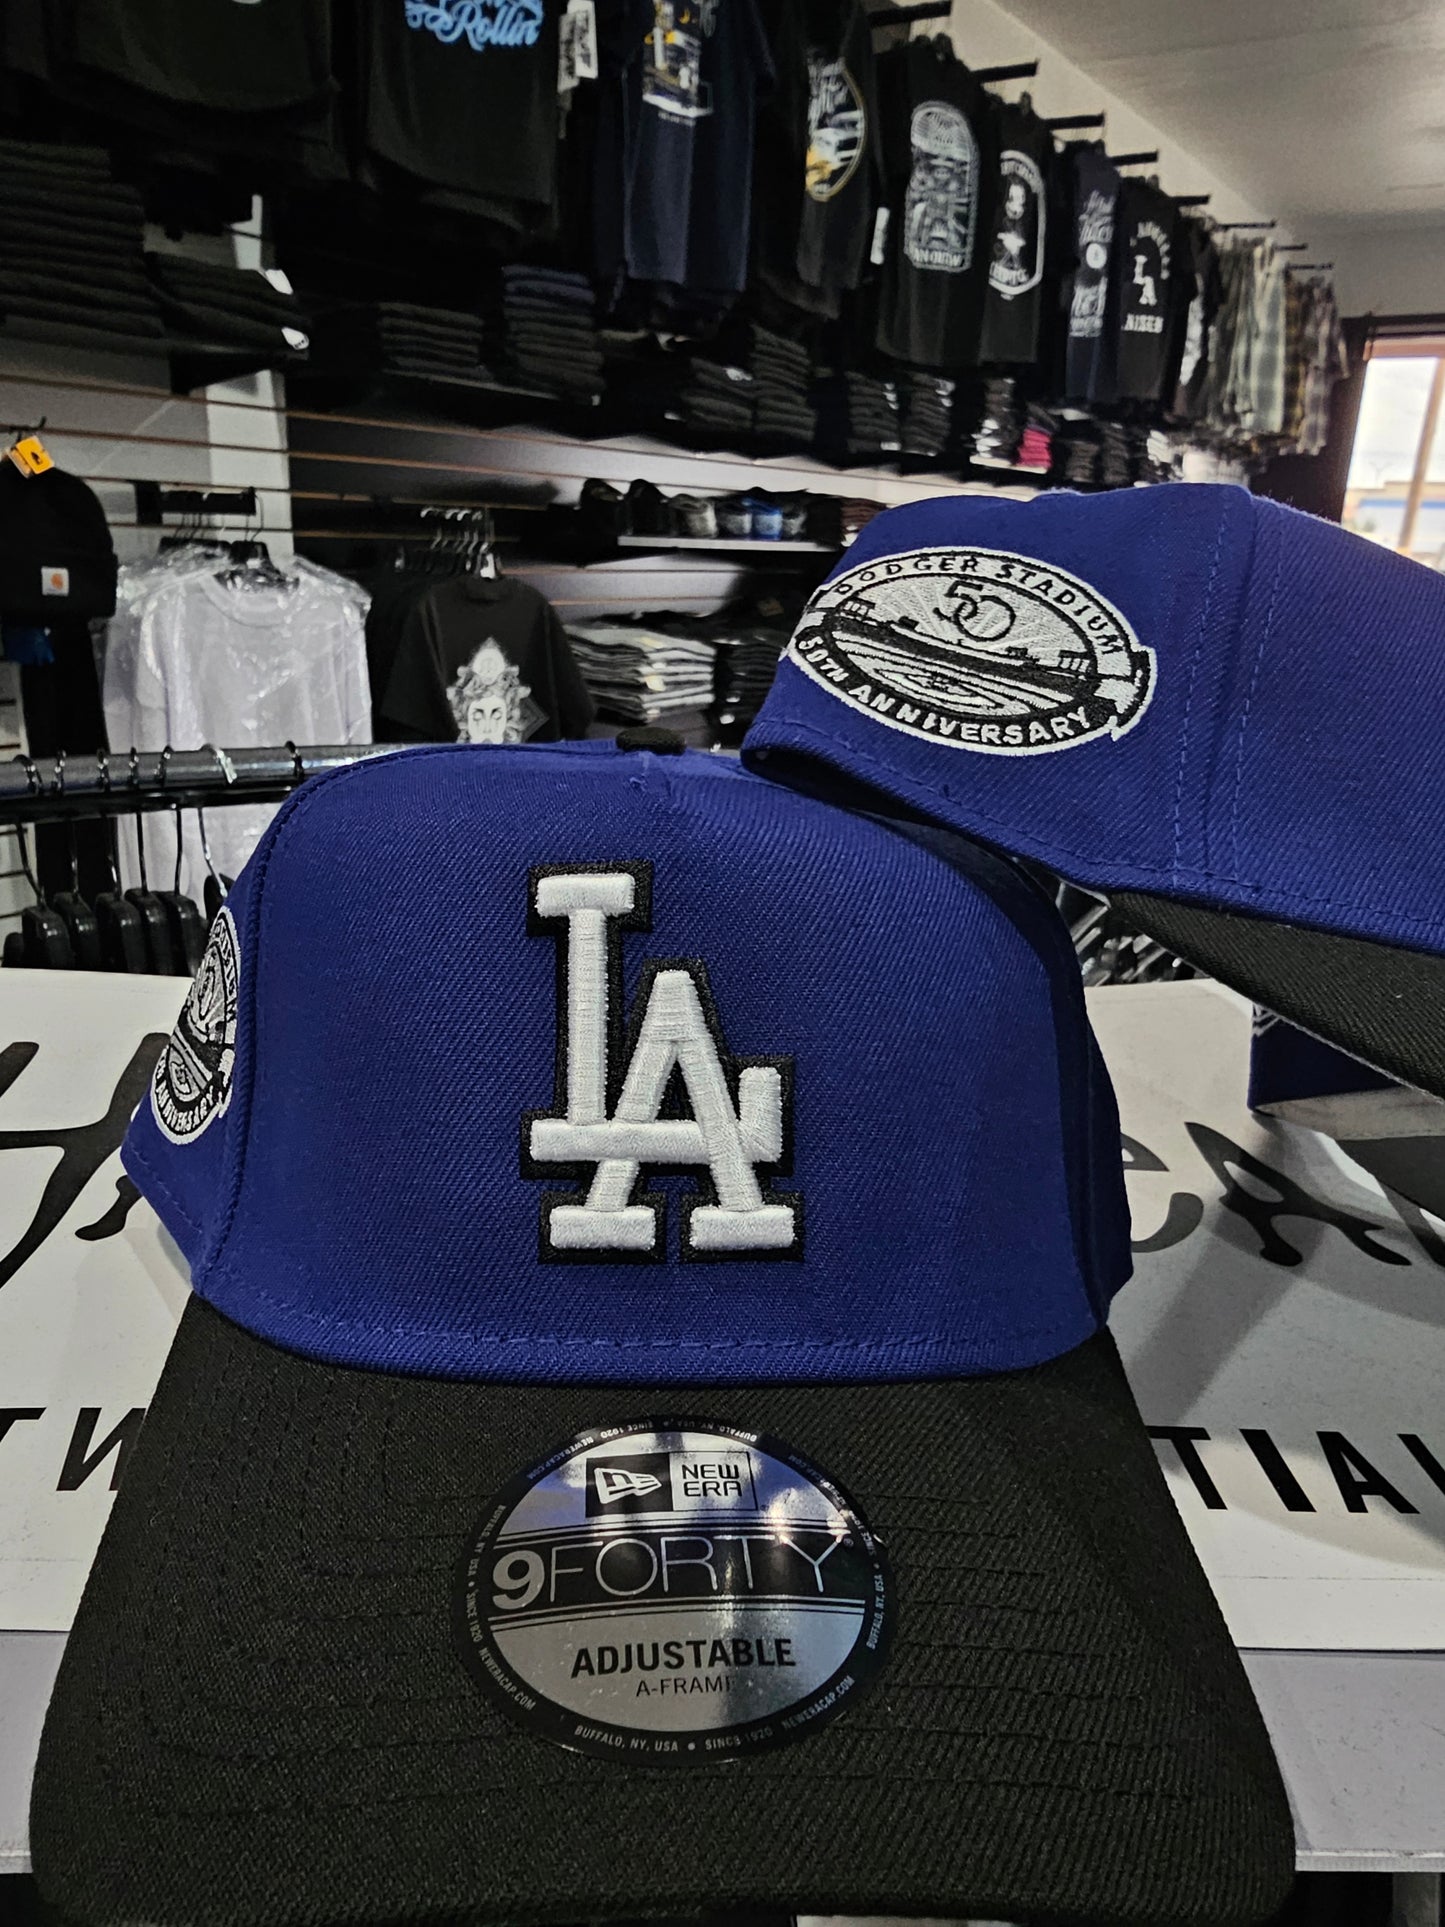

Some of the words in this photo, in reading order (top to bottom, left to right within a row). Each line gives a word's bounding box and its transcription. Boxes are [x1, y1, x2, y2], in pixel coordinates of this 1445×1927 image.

[835, 555, 980, 596] DODGER
[996, 563, 1123, 655] STADIUM
[933, 580, 1016, 642] 50
[797, 635, 850, 685] 50TH
[849, 680, 1092, 745] ANNIVERSARY
[529, 870, 799, 1251] LA
[681, 1463, 740, 1480] NEW
[684, 1480, 743, 1498] ERA
[491, 1532, 844, 1610] 9FORTY
[478, 1647, 537, 1711] NEWERACAP.COM
[571, 1638, 796, 1680] ADJUSTABLE
[574, 1724, 626, 1749] BUFFALO,
[654, 1740, 679, 1752] USA
[781, 1674, 856, 1731] NEWERACAP.COM
